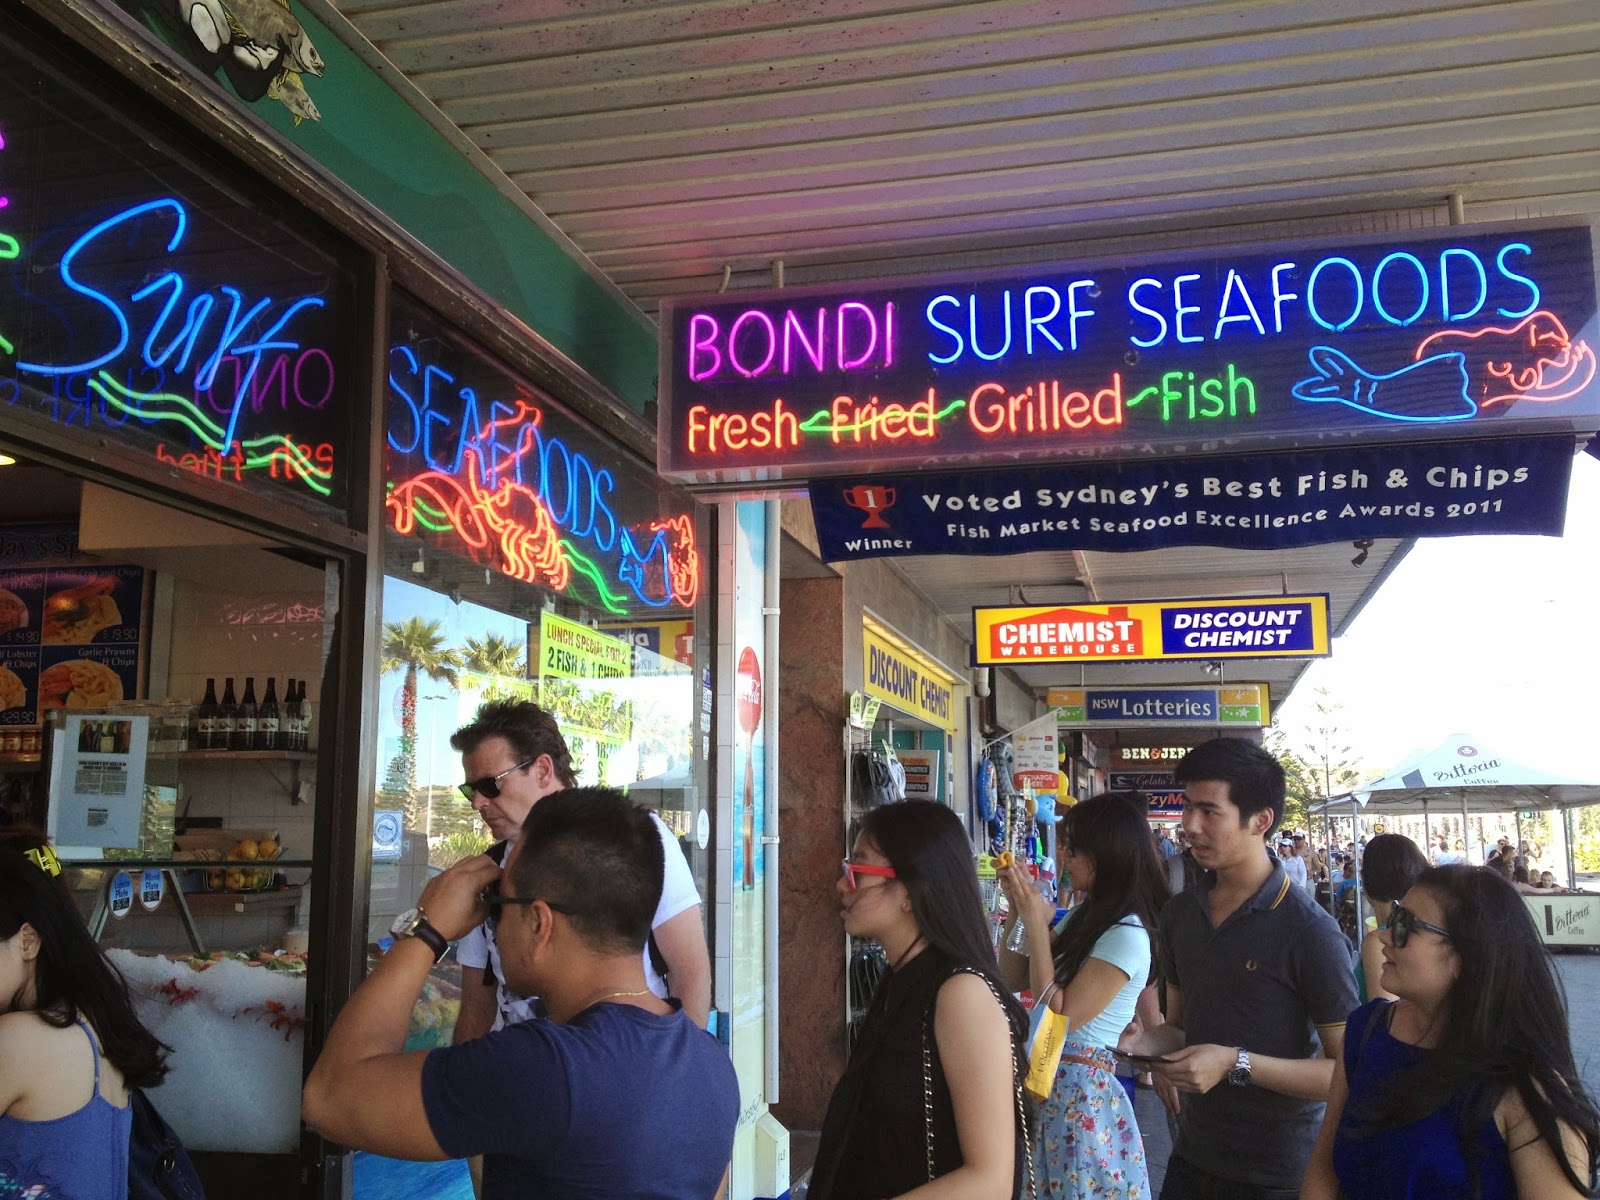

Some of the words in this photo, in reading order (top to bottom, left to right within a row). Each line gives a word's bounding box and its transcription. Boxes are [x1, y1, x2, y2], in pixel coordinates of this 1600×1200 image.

[688, 301, 895, 381] BONDI
[926, 279, 1096, 365] SURF
[1128, 243, 1541, 348] SEAFOODS
[16, 198, 325, 455] Surf
[688, 398, 798, 453] Fresh
[968, 372, 1124, 434] Grilled
[1162, 364, 1256, 420] Fish
[387, 345, 617, 552] SEAFOODS
[864, 490, 878, 508] 1
[922, 489, 1022, 513] Voted
[1036, 480, 1189, 509] Sydney's
[1202, 476, 1282, 499] Best
[1298, 469, 1368, 496] Fish
[1385, 467, 1409, 489] &
[1426, 464, 1530, 491] Chips
[946, 523, 991, 539] Fish
[1000, 516, 1081, 539] Market
[1089, 511, 1188, 534] Seafood
[1196, 508, 1328, 529] Excellence
[1338, 502, 1435, 519] Awards
[1446, 499, 1504, 518] 2011
[845, 537, 913, 552] Winner
[1174, 610, 1302, 629] DISCOUNT
[999, 620, 1134, 644] CHEMIST
[1184, 629, 1292, 648] CHEMIST
[7, 649, 38, 658] Lobster
[78, 648, 103, 657] Garlic
[105, 647, 136, 657] Prawns
[547, 622, 574, 648] LUNCH
[576, 633, 604, 659] SPECIAL
[621, 650, 627, 666] 2
[1000, 643, 1136, 656] WAREHOUSE
[14, 659, 37, 669] Chips
[111, 657, 136, 667] Chips
[547, 647, 554, 669] 2
[556, 649, 578, 676] FISH
[869, 644, 918, 705] DISCOUNT
[920, 676, 951, 721] CHEMIST
[1092, 698, 1119, 710] NSW
[1122, 697, 1212, 717] Lotteries
